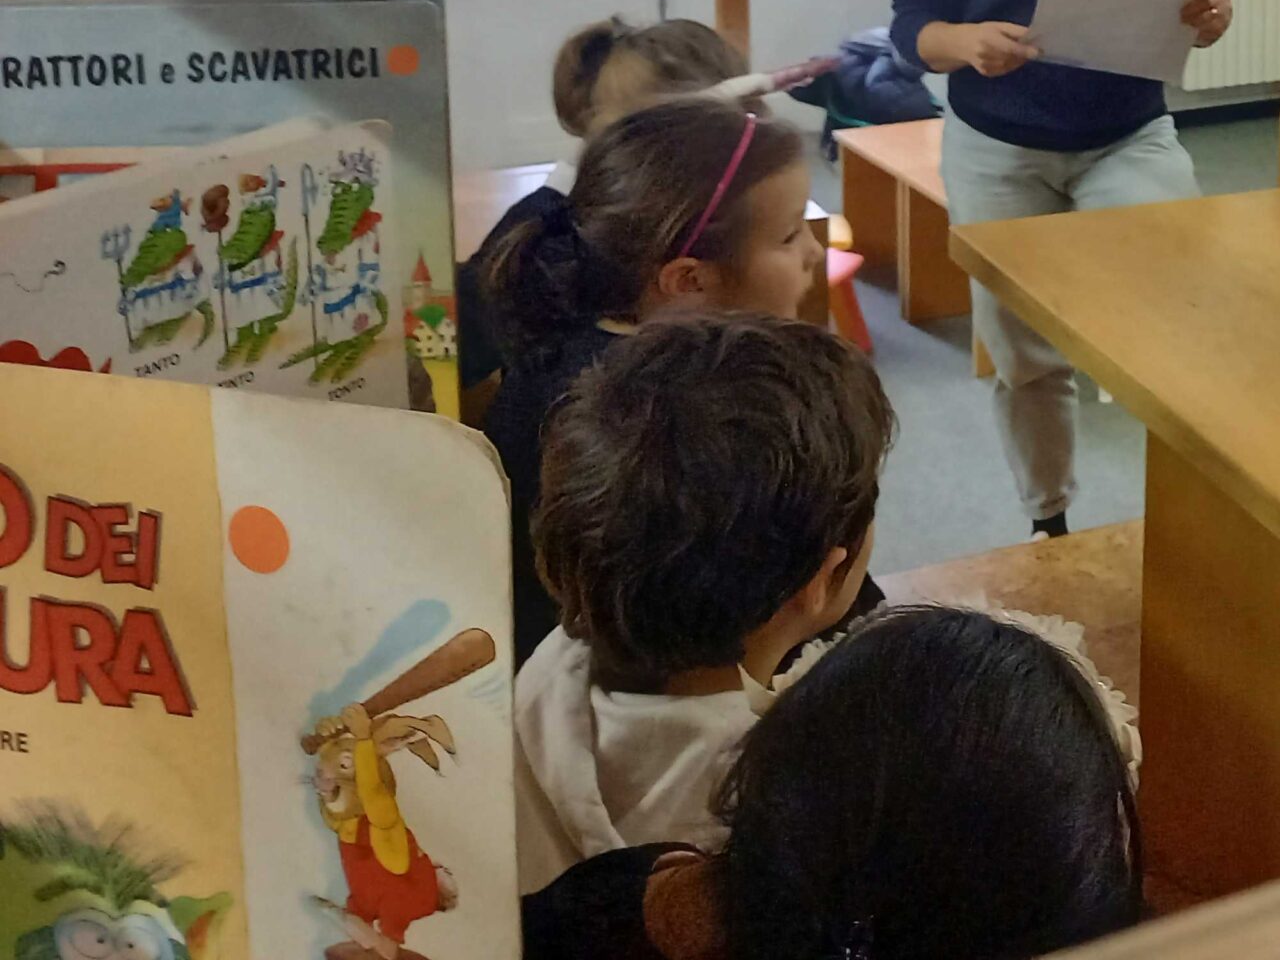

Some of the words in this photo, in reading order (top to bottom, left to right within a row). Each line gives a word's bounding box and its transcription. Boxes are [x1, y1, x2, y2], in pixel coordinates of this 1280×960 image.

[2, 52, 146, 89] RATTORI
[160, 62, 176, 84] e
[186, 46, 380, 84] SCAVATRICI
[133, 353, 180, 378] TANTO
[44, 493, 162, 591] DEI
[0, 585, 197, 717] URA
